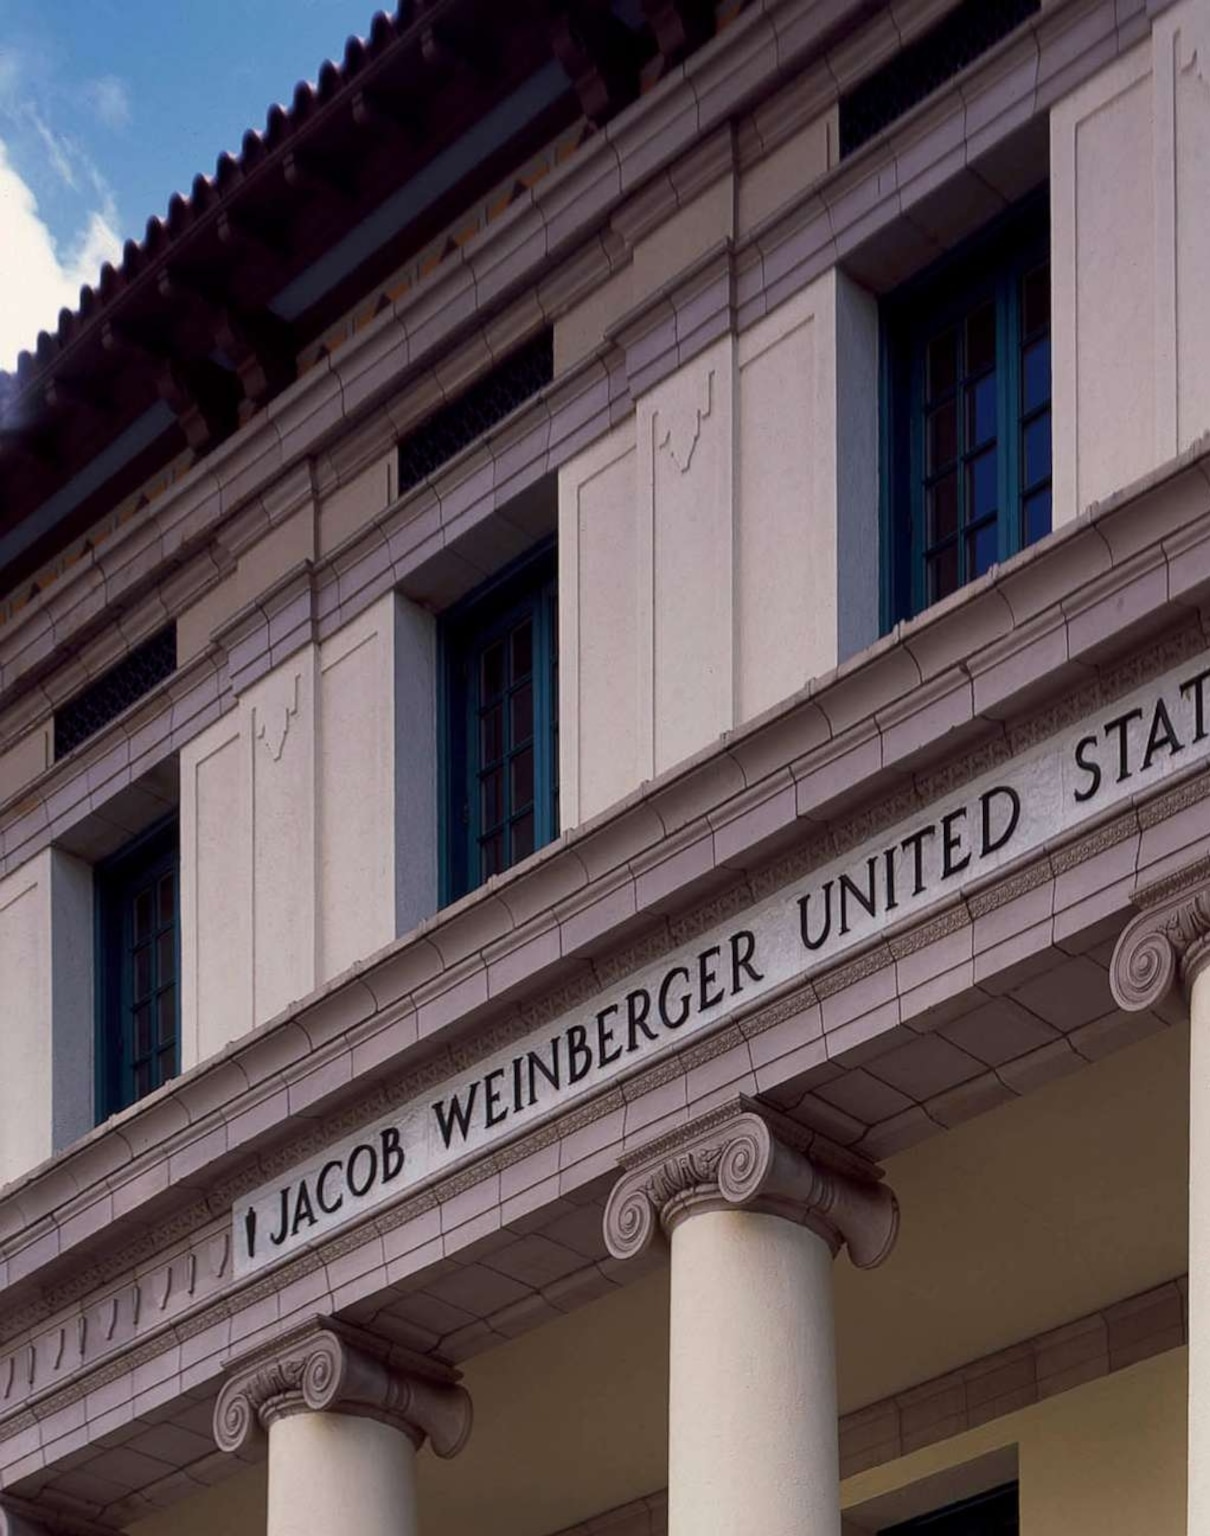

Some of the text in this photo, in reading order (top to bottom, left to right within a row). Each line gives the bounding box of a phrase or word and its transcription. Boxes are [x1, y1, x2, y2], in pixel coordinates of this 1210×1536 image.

[270, 1127, 405, 1245] JACOB
[432, 930, 764, 1149] WEINBERGER
[797, 786, 1021, 950] UNITED
